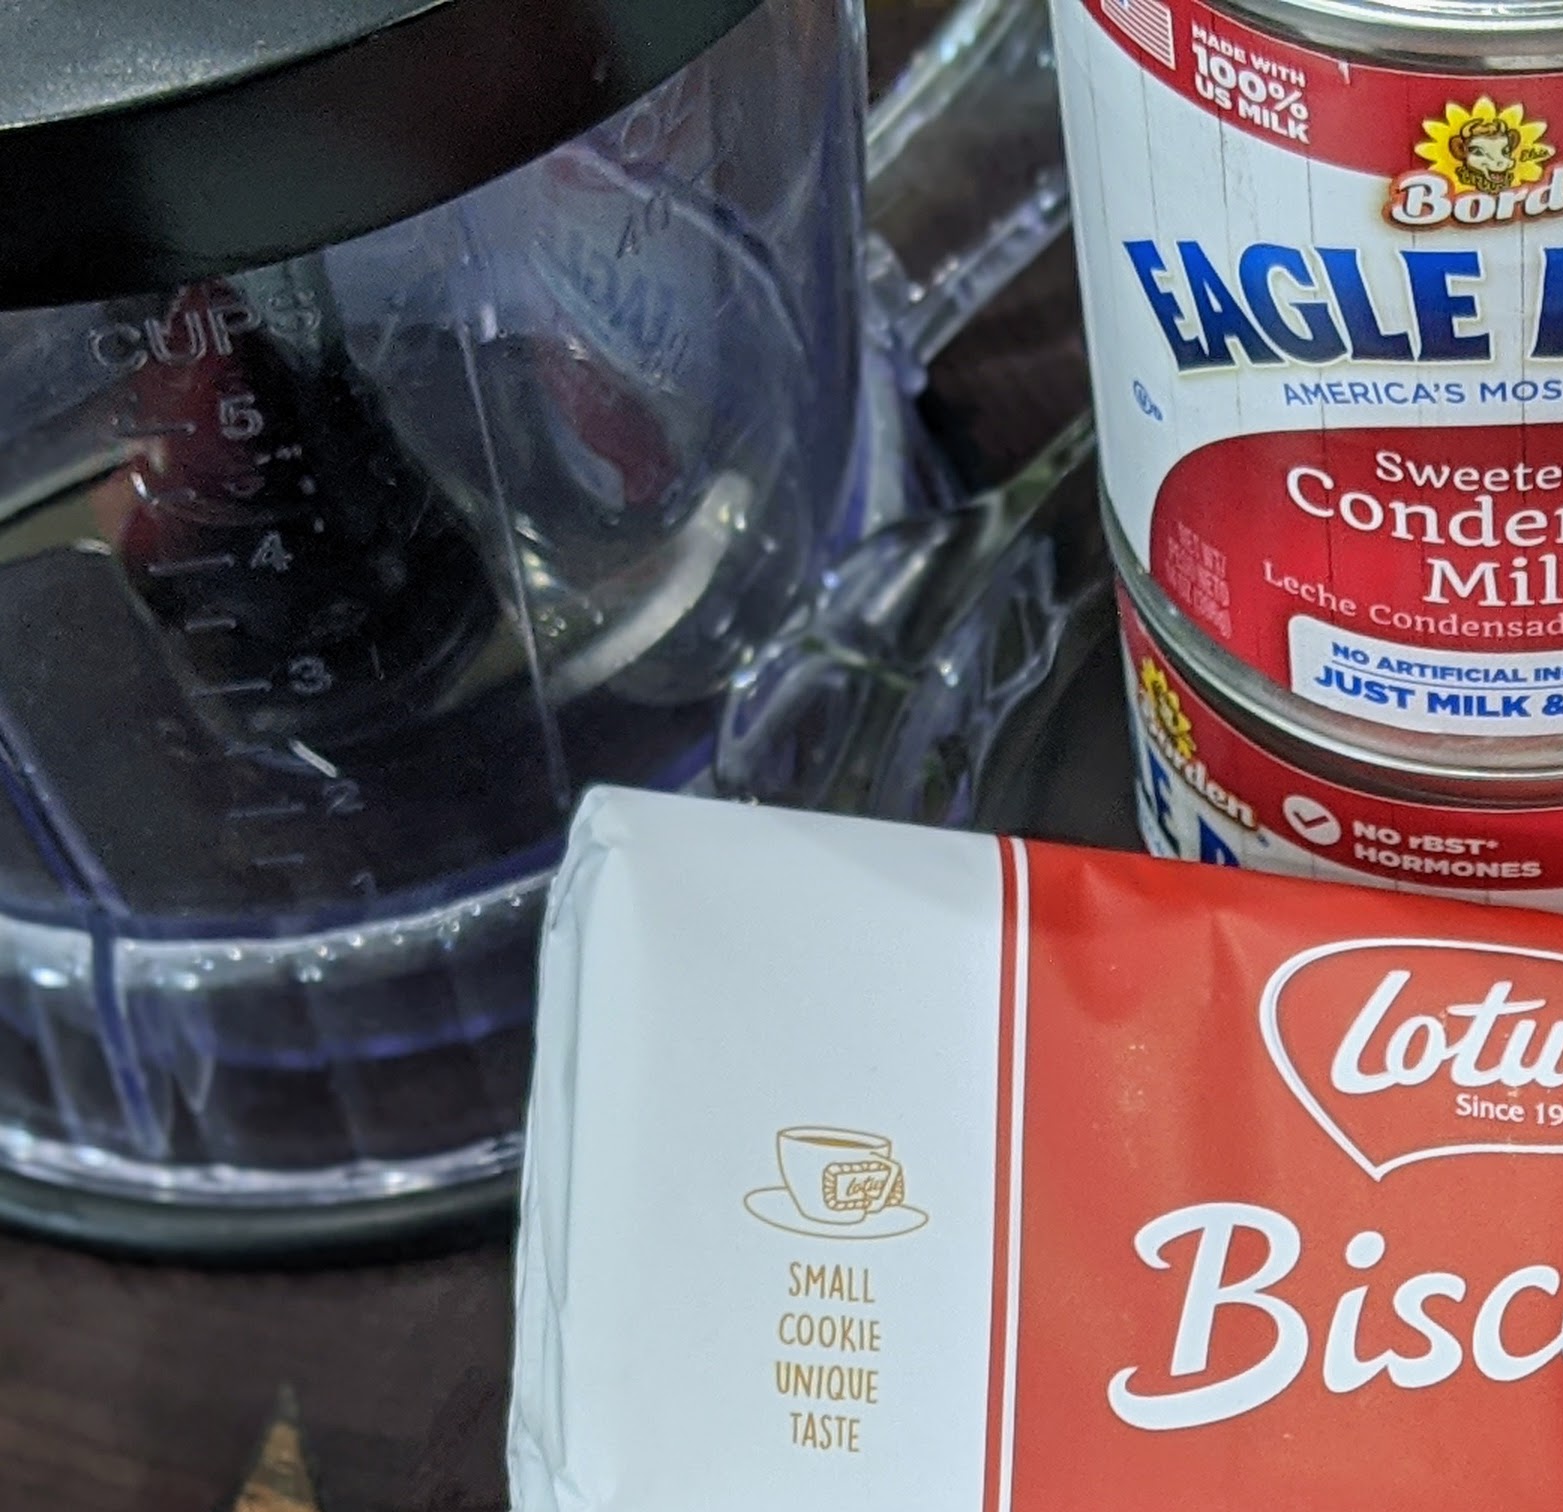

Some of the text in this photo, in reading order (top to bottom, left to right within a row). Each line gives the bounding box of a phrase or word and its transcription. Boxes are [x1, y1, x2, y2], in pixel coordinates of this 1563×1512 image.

[1191, 19, 1306, 88] MADE WITH
[1192, 42, 1310, 121] 100%
[1194, 71, 1311, 145] US MILK
[1121, 238, 1493, 374] EAGLE
[87, 291, 323, 371] CUPS
[1282, 380, 1467, 408] AMERICA'S
[219, 393, 265, 441] 5
[250, 530, 295, 574] 4
[1262, 557, 1358, 617] Leche
[1330, 641, 1371, 667] NO
[1375, 655, 1528, 685] ARTIFICIAL
[1313, 664, 1416, 711] JUST
[1425, 690, 1532, 719] MILK
[1352, 819, 1402, 847] NO
[1353, 842, 1542, 880] HORMONES
[1454, 1092, 1526, 1124] Since
[788, 1260, 877, 1305] SMALL
[778, 1311, 883, 1354] COOKIE
[775, 1359, 880, 1405] UNIQUE
[789, 1411, 863, 1454] TASTE
